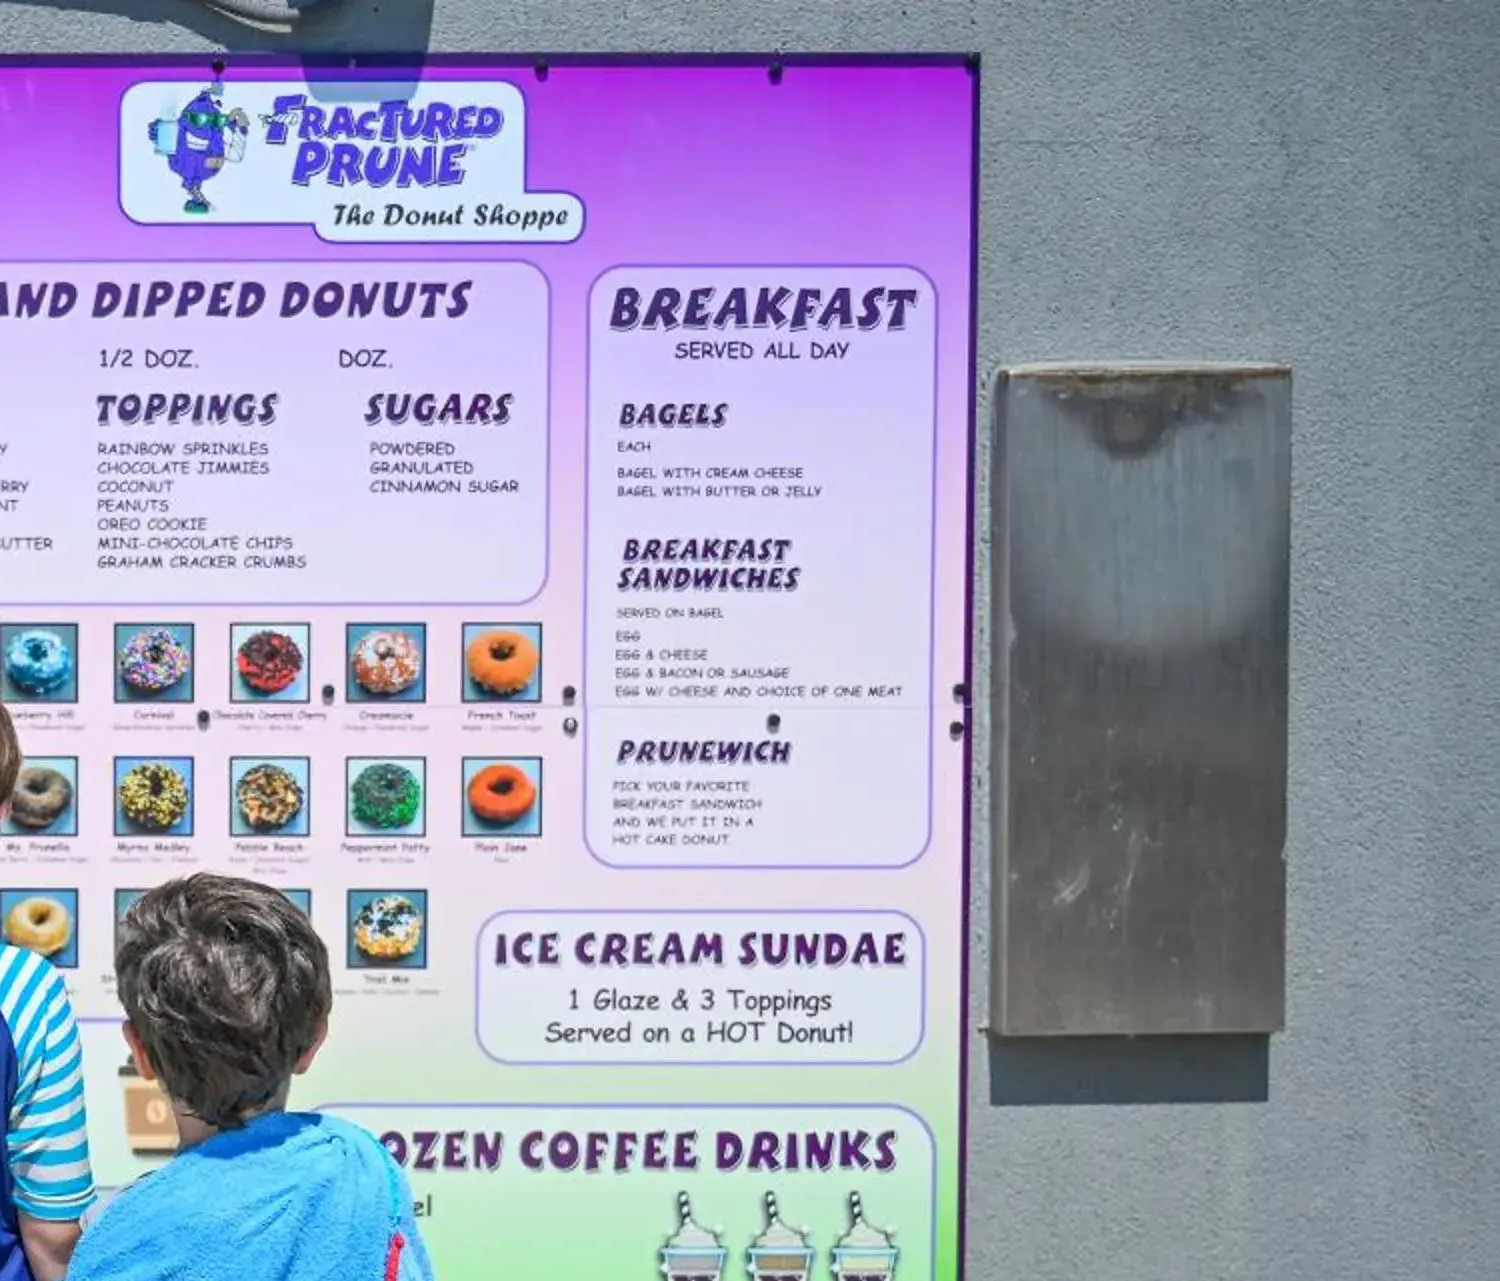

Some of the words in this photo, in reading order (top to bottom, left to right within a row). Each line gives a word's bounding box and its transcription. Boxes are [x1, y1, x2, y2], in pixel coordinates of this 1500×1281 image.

[292, 140, 467, 188] PRUNE
[334, 204, 374, 225] The
[384, 204, 463, 226] Donut
[474, 204, 568, 231] Shoppe
[92, 281, 266, 318] DIPPED
[280, 280, 473, 318] DONUTS
[610, 286, 917, 332] BREAKFAST
[675, 341, 754, 360] SERVED
[764, 342, 800, 359] ALL
[811, 342, 850, 359] DAY
[100, 349, 132, 368] 1/2
[145, 349, 198, 368] DOZ.
[339, 349, 392, 368] DOZ.
[97, 393, 278, 426] TOPPINGS
[364, 393, 513, 426] SUGARS
[620, 403, 728, 428] BAGELS
[98, 442, 175, 456] RAINBOW
[183, 442, 268, 456] SPRINKLES
[370, 441, 455, 456] POWDERED
[618, 441, 651, 452] EACH
[97, 461, 189, 475] CHOCOLATE
[197, 461, 270, 475] JIMMIES
[370, 461, 473, 474] GRANULATED
[618, 467, 656, 478] BAGEL
[663, 468, 700, 478] WITH
[706, 467, 749, 478] CREAM
[754, 467, 804, 478] CHEESE
[97, 479, 174, 494] COCONUT
[370, 480, 461, 493] CINNAMON
[468, 480, 519, 493] SUGAR
[618, 486, 656, 497] BAGEL
[662, 486, 700, 496] WITH
[706, 485, 756, 497] BUTTER
[761, 485, 780, 496] OR
[785, 486, 822, 497] JELLY
[98, 499, 169, 513] PEANUTS
[97, 517, 140, 531] OREO
[147, 517, 207, 531] COOKIE
[98, 535, 239, 550] MINI-CHOCOLATE
[246, 536, 293, 550] CHIPS
[623, 538, 791, 563] BREAKFAST
[98, 555, 163, 568] GRAHAM
[170, 555, 236, 568] CRACKER
[244, 555, 306, 568] CRUMBS
[618, 567, 801, 591] SANDWICHES
[617, 608, 661, 618] SERVED
[665, 608, 684, 618] ON
[689, 608, 723, 618] BAGEL
[616, 631, 640, 642] EGG
[616, 649, 640, 661] EGG
[659, 648, 708, 660] CHEESE
[616, 668, 640, 679] EGG
[659, 667, 703, 678] BACON
[706, 667, 725, 678] OR
[731, 667, 789, 679] SAUSAGE
[616, 685, 640, 697] EGG
[669, 685, 717, 697] CHEESE
[724, 686, 751, 697] AND
[756, 686, 805, 697] CHOICE
[811, 685, 828, 697] OF
[833, 685, 862, 697] ONE
[868, 685, 902, 697] MEAT
[617, 740, 791, 764] PRUNEWICH
[613, 781, 640, 792] PICK
[647, 781, 681, 792] YOUR
[686, 780, 749, 792] FAVORITE
[613, 798, 684, 810] BREAKFAST
[691, 799, 762, 810] SANDWICH
[613, 817, 640, 827] AND
[646, 816, 666, 828] WE
[672, 816, 696, 827] PUT
[702, 816, 716, 827] IT
[723, 816, 740, 827] IN
[613, 834, 640, 845] HOT
[646, 834, 676, 845] CAKE
[495, 932, 559, 965] ICE
[575, 932, 723, 966] CREAM
[738, 932, 905, 967] SUNDAE
[570, 988, 578, 1010] 1
[594, 988, 660, 1011] Glaze
[671, 989, 688, 1011] &
[701, 989, 714, 1010] 3
[727, 989, 832, 1017] Toppings
[545, 1021, 631, 1043] Served
[643, 1028, 669, 1043] on
[681, 1028, 695, 1043] a
[707, 1021, 766, 1043] HOT
[778, 1021, 852, 1043] Donut!
[379, 1130, 504, 1173] OZEN
[520, 1130, 699, 1172] COFFEE
[716, 1130, 896, 1173] DRINKS
